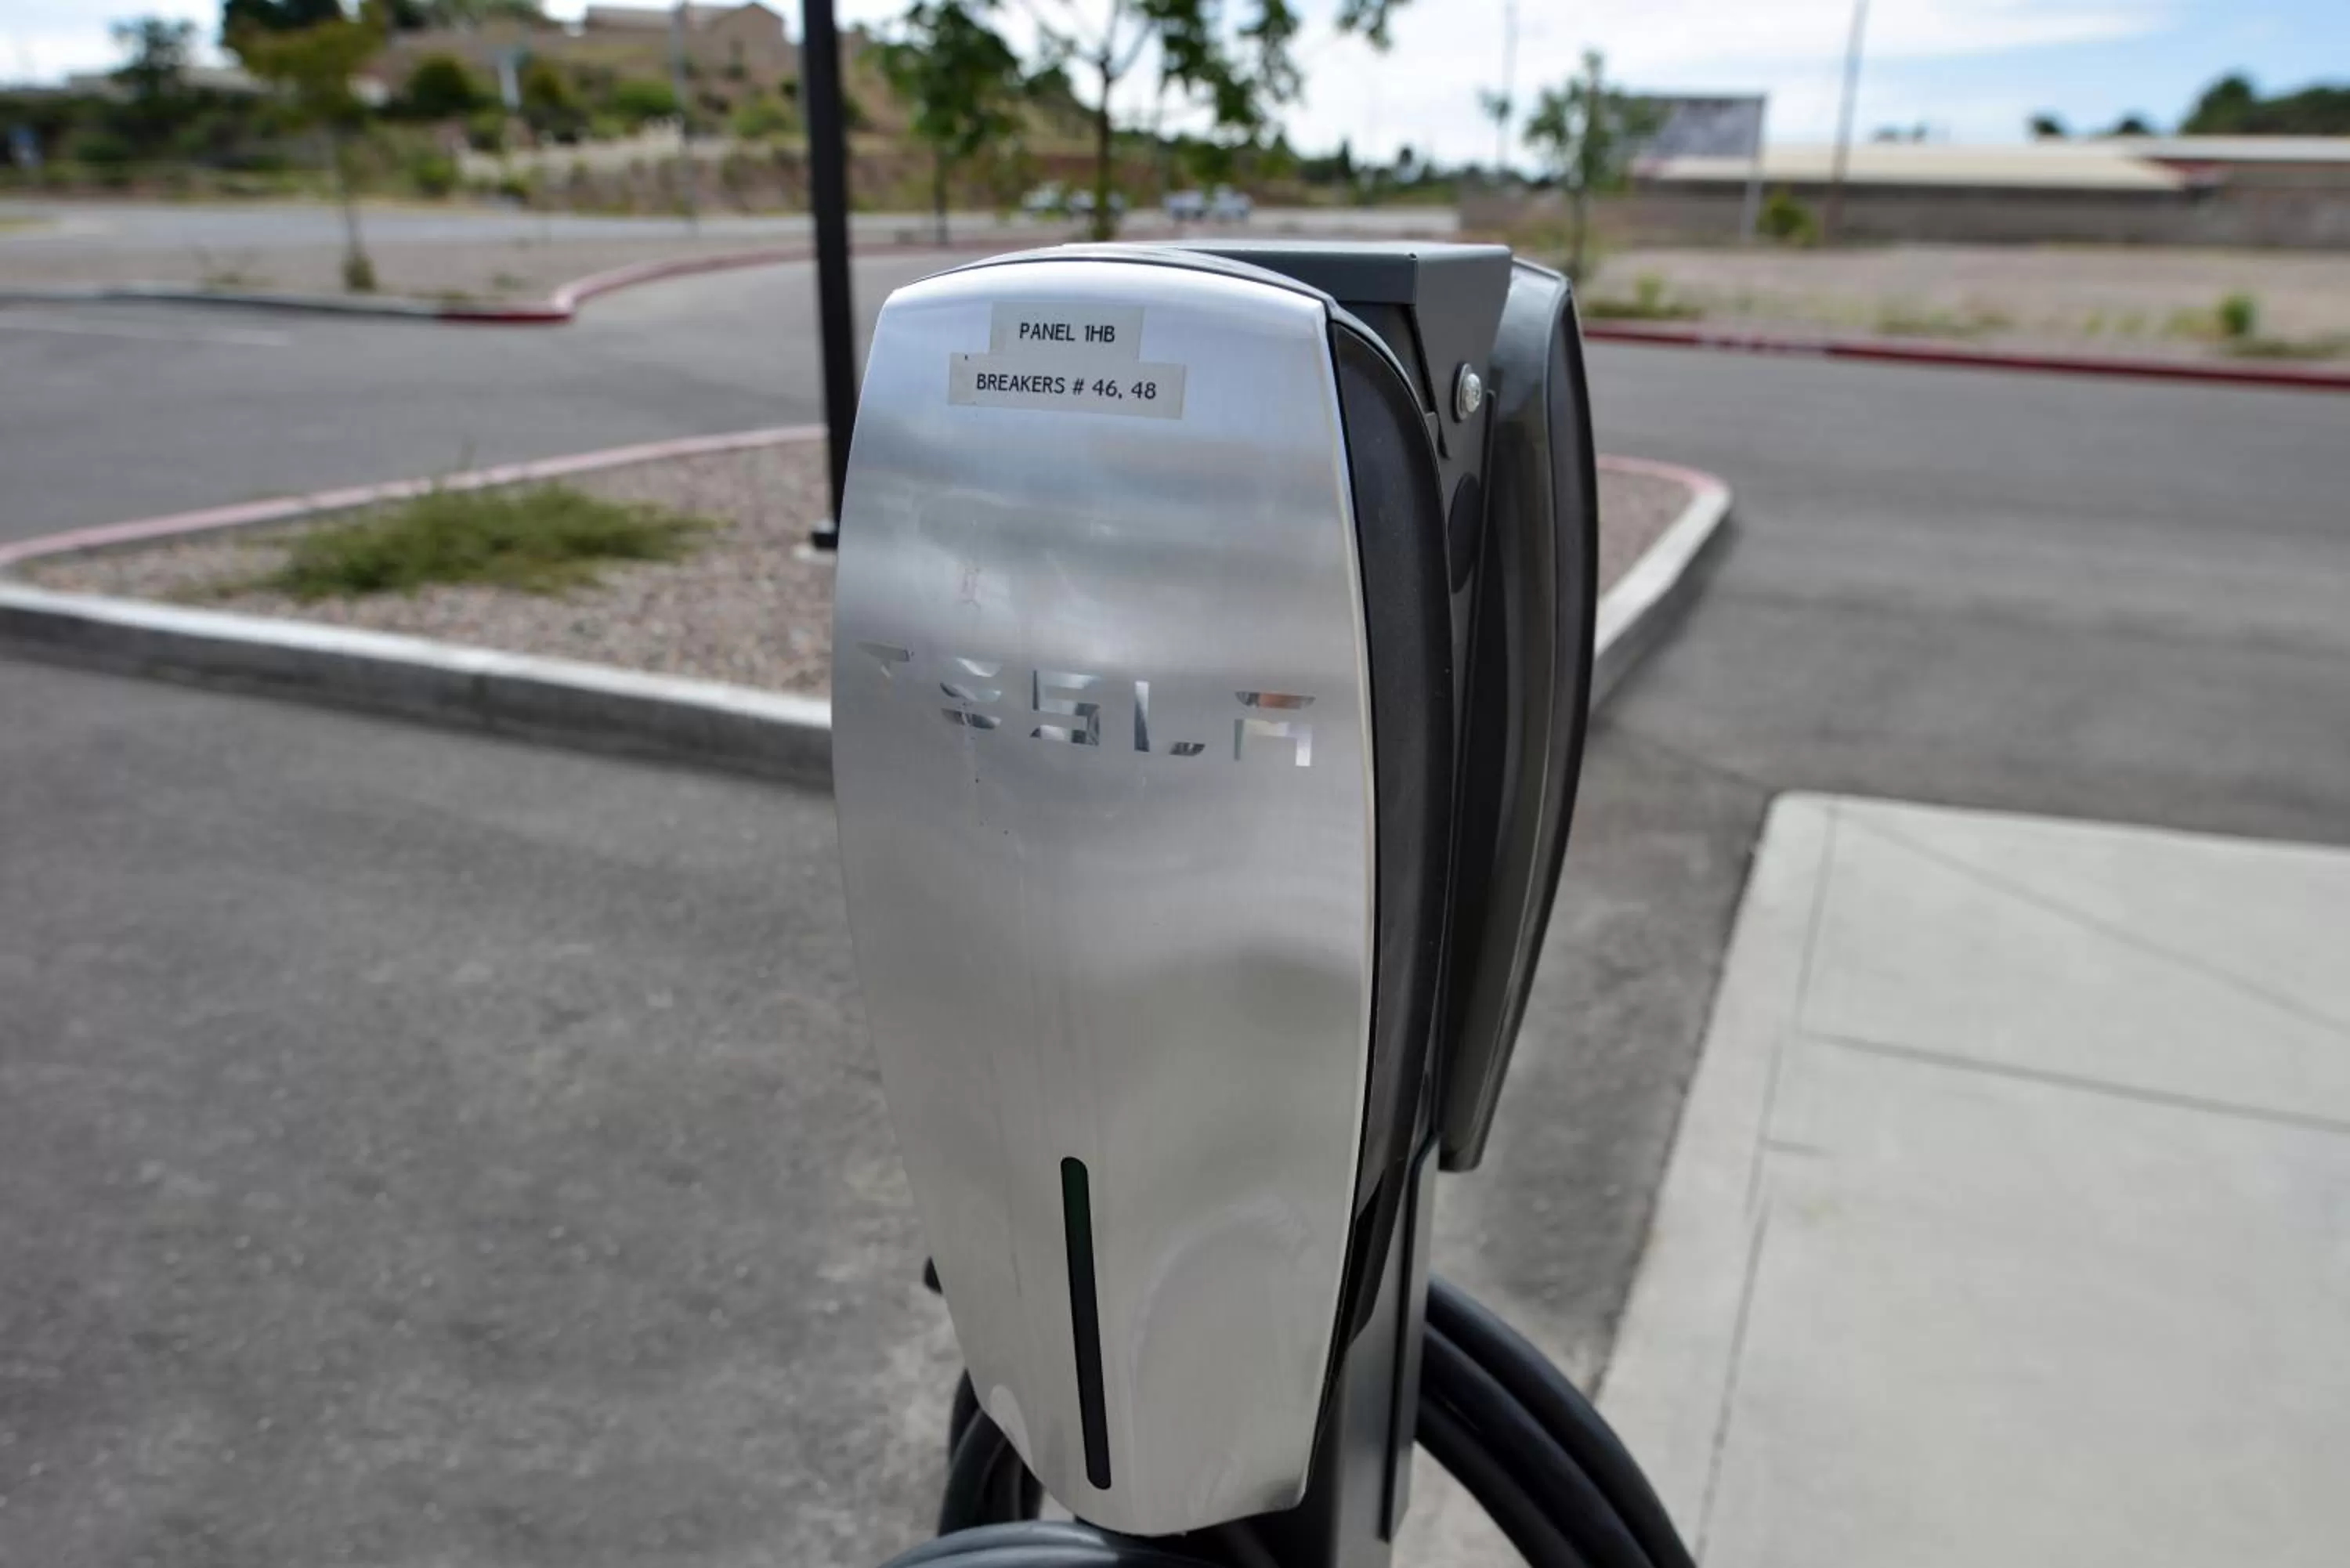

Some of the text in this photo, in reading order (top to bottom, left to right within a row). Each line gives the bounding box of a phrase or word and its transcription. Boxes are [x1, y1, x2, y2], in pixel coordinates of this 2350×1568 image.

[1019, 322, 1115, 343] PANEL 1HB
[976, 373, 1157, 399] BREAKERS # 46, 48
